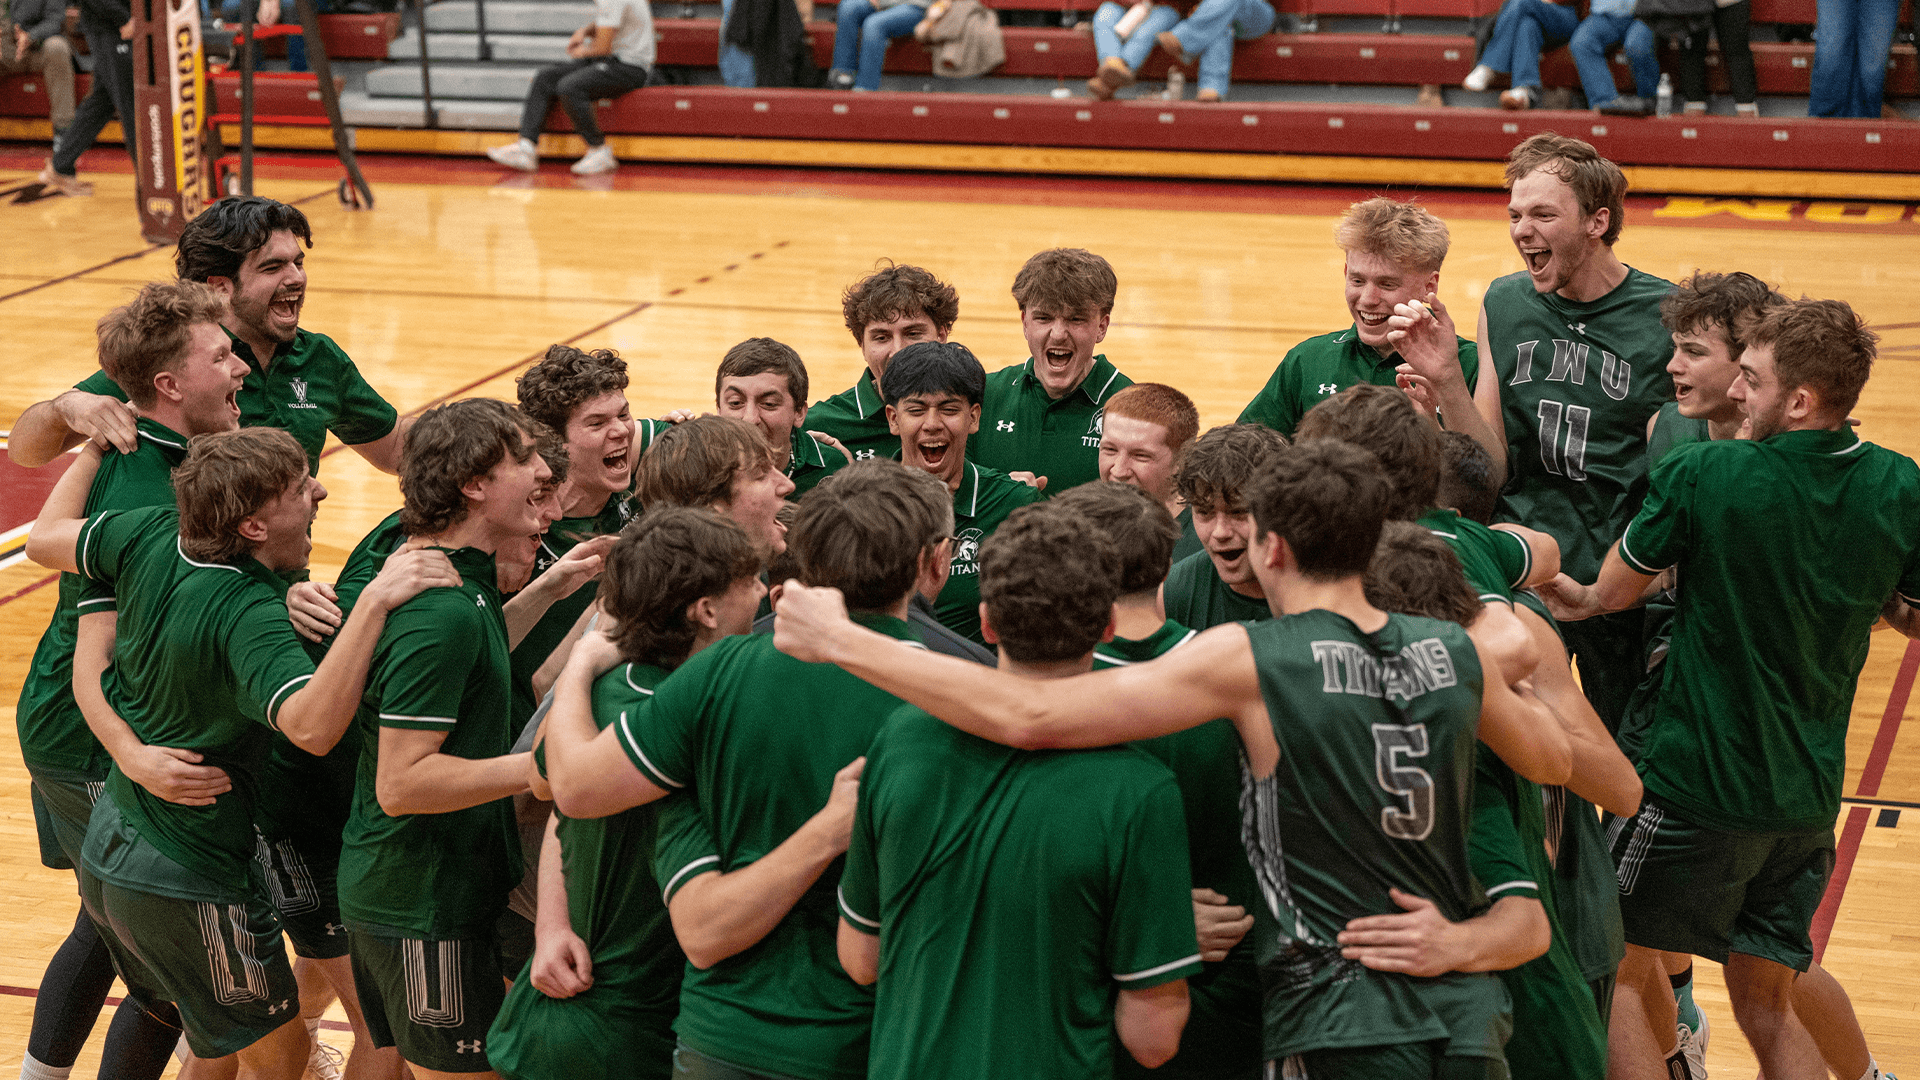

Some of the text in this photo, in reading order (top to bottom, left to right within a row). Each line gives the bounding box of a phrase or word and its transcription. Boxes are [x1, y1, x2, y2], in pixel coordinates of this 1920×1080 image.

[176, 26, 202, 222] COUGARS
[1509, 339, 1631, 401] IWU
[1537, 399, 1591, 482] 11
[949, 562, 981, 576] ITAN
[1310, 637, 1458, 701] TITANS
[1371, 722, 1436, 841] 5
